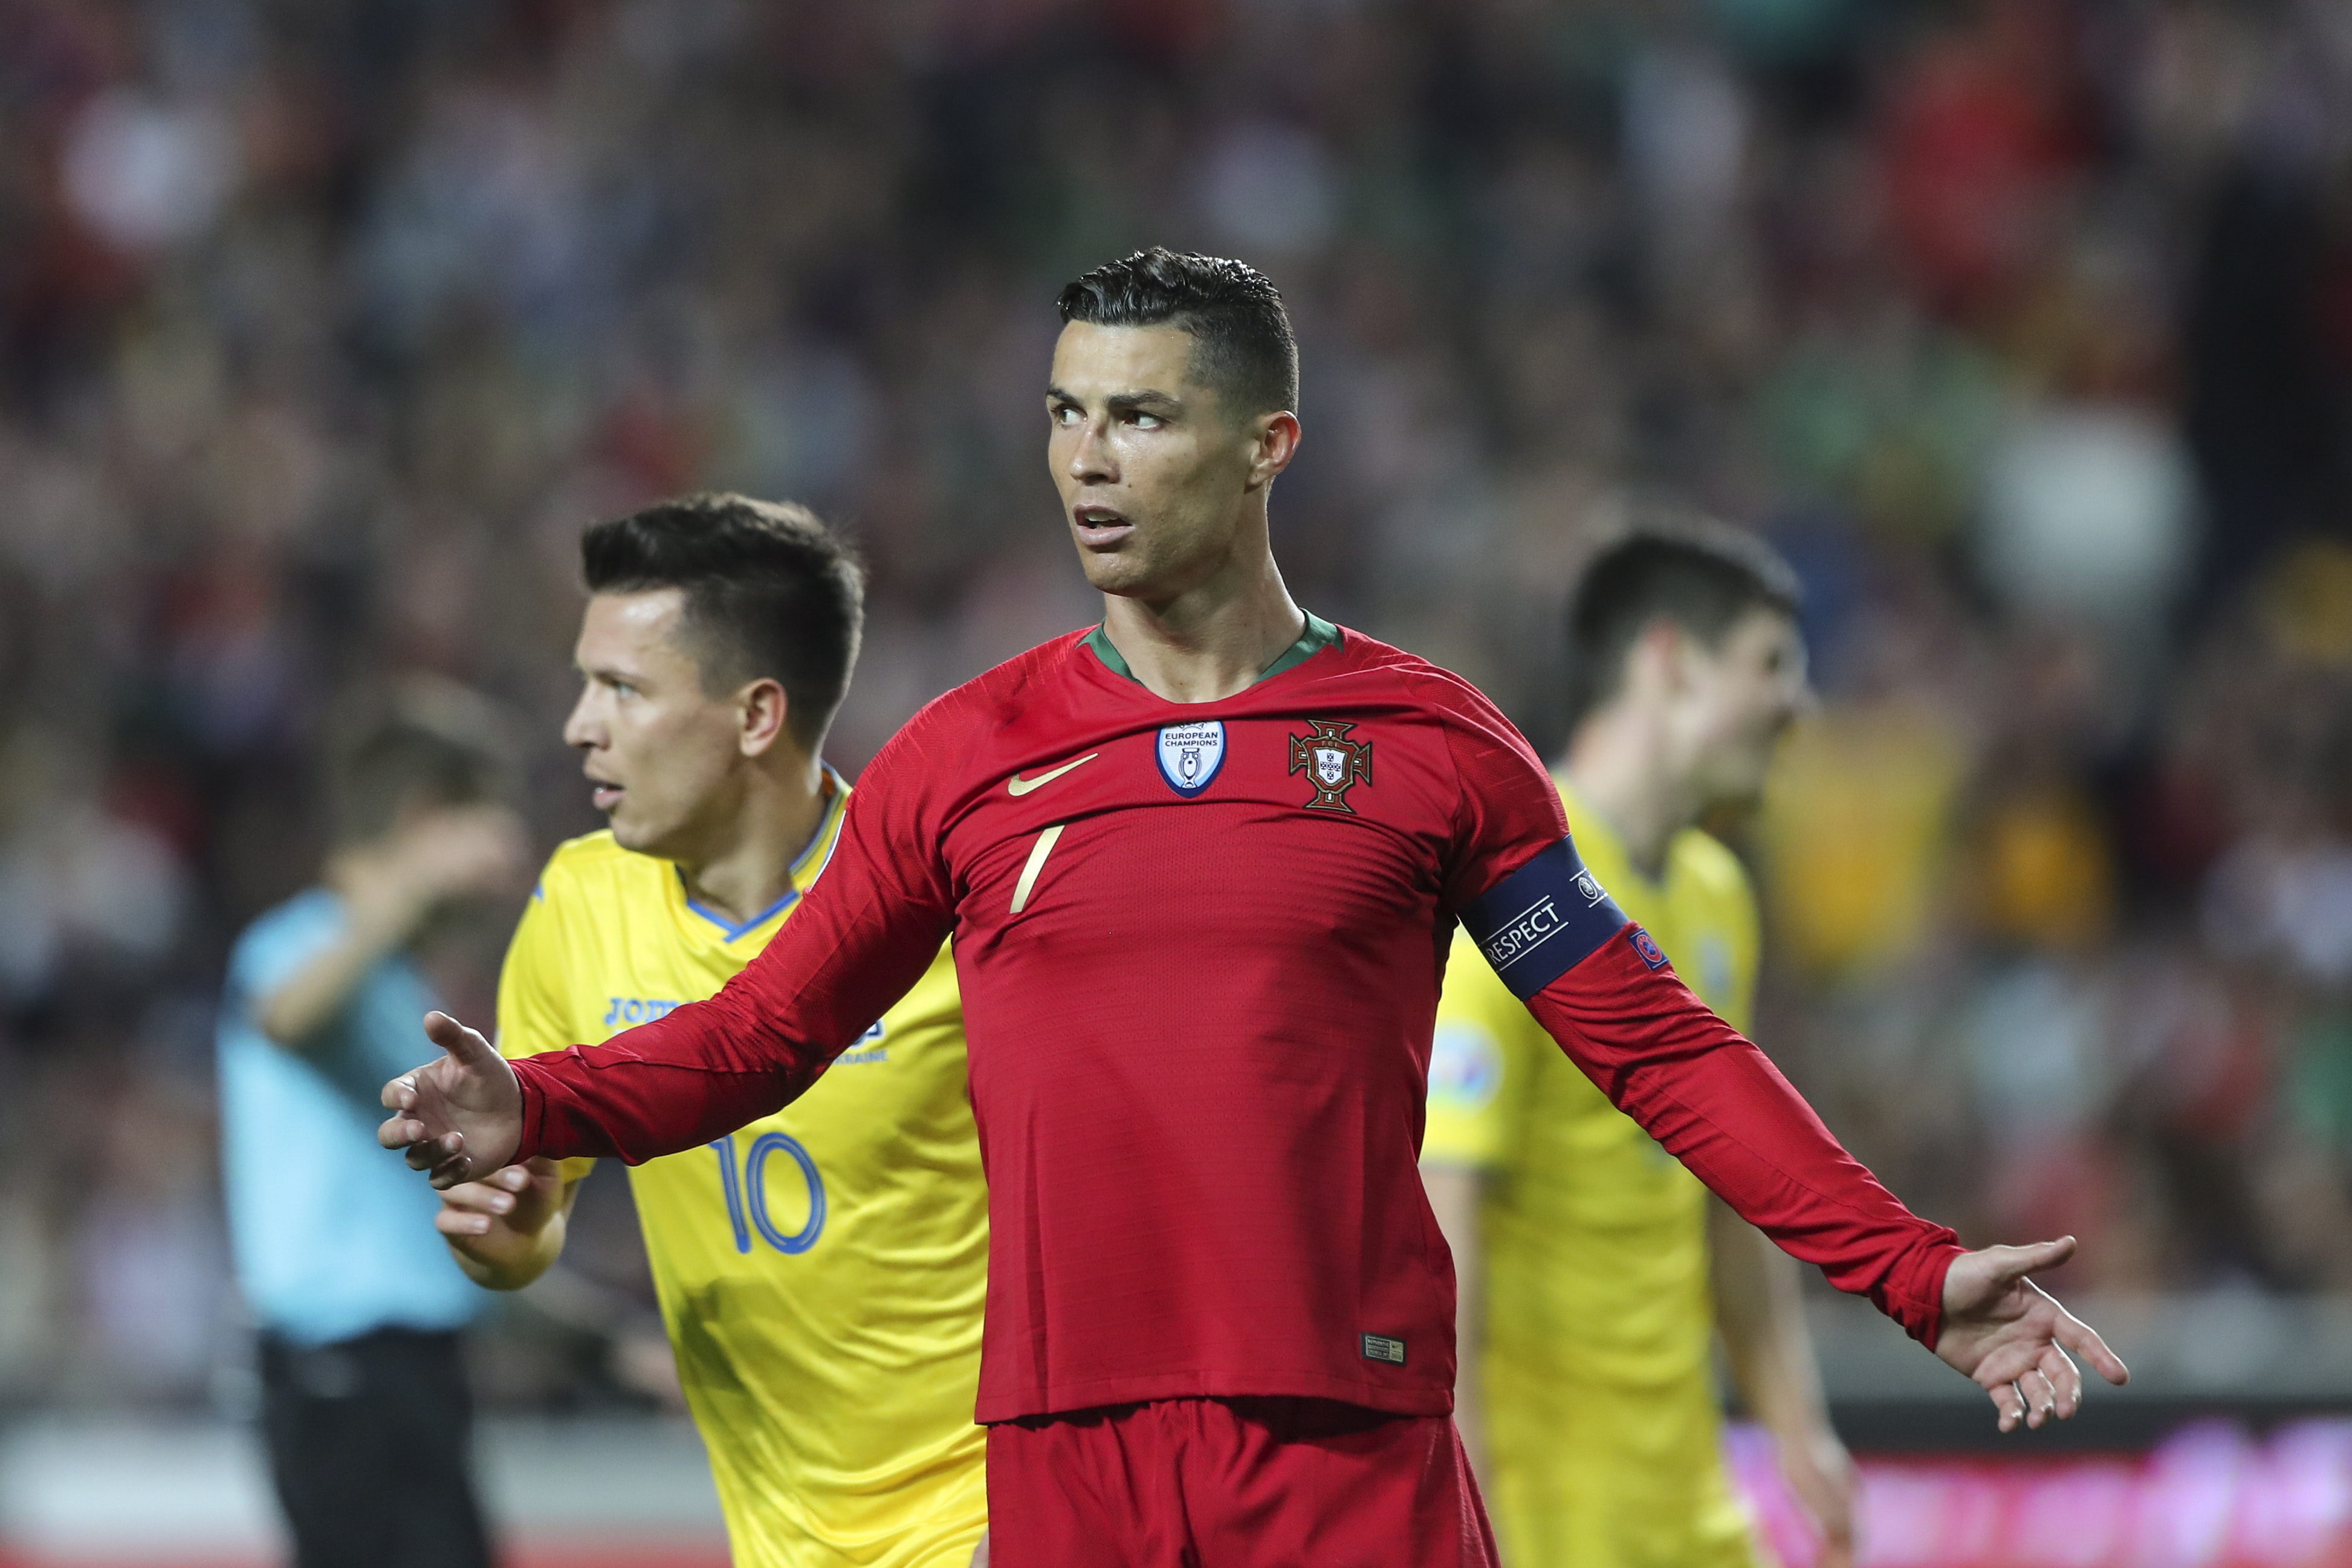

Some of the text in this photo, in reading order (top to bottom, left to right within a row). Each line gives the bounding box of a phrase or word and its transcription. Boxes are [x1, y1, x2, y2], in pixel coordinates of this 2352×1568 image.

[1165, 731, 1218, 740] EUROPEAN
[1486, 902, 1560, 965] RESPECT
[708, 1132, 827, 1255] 10
